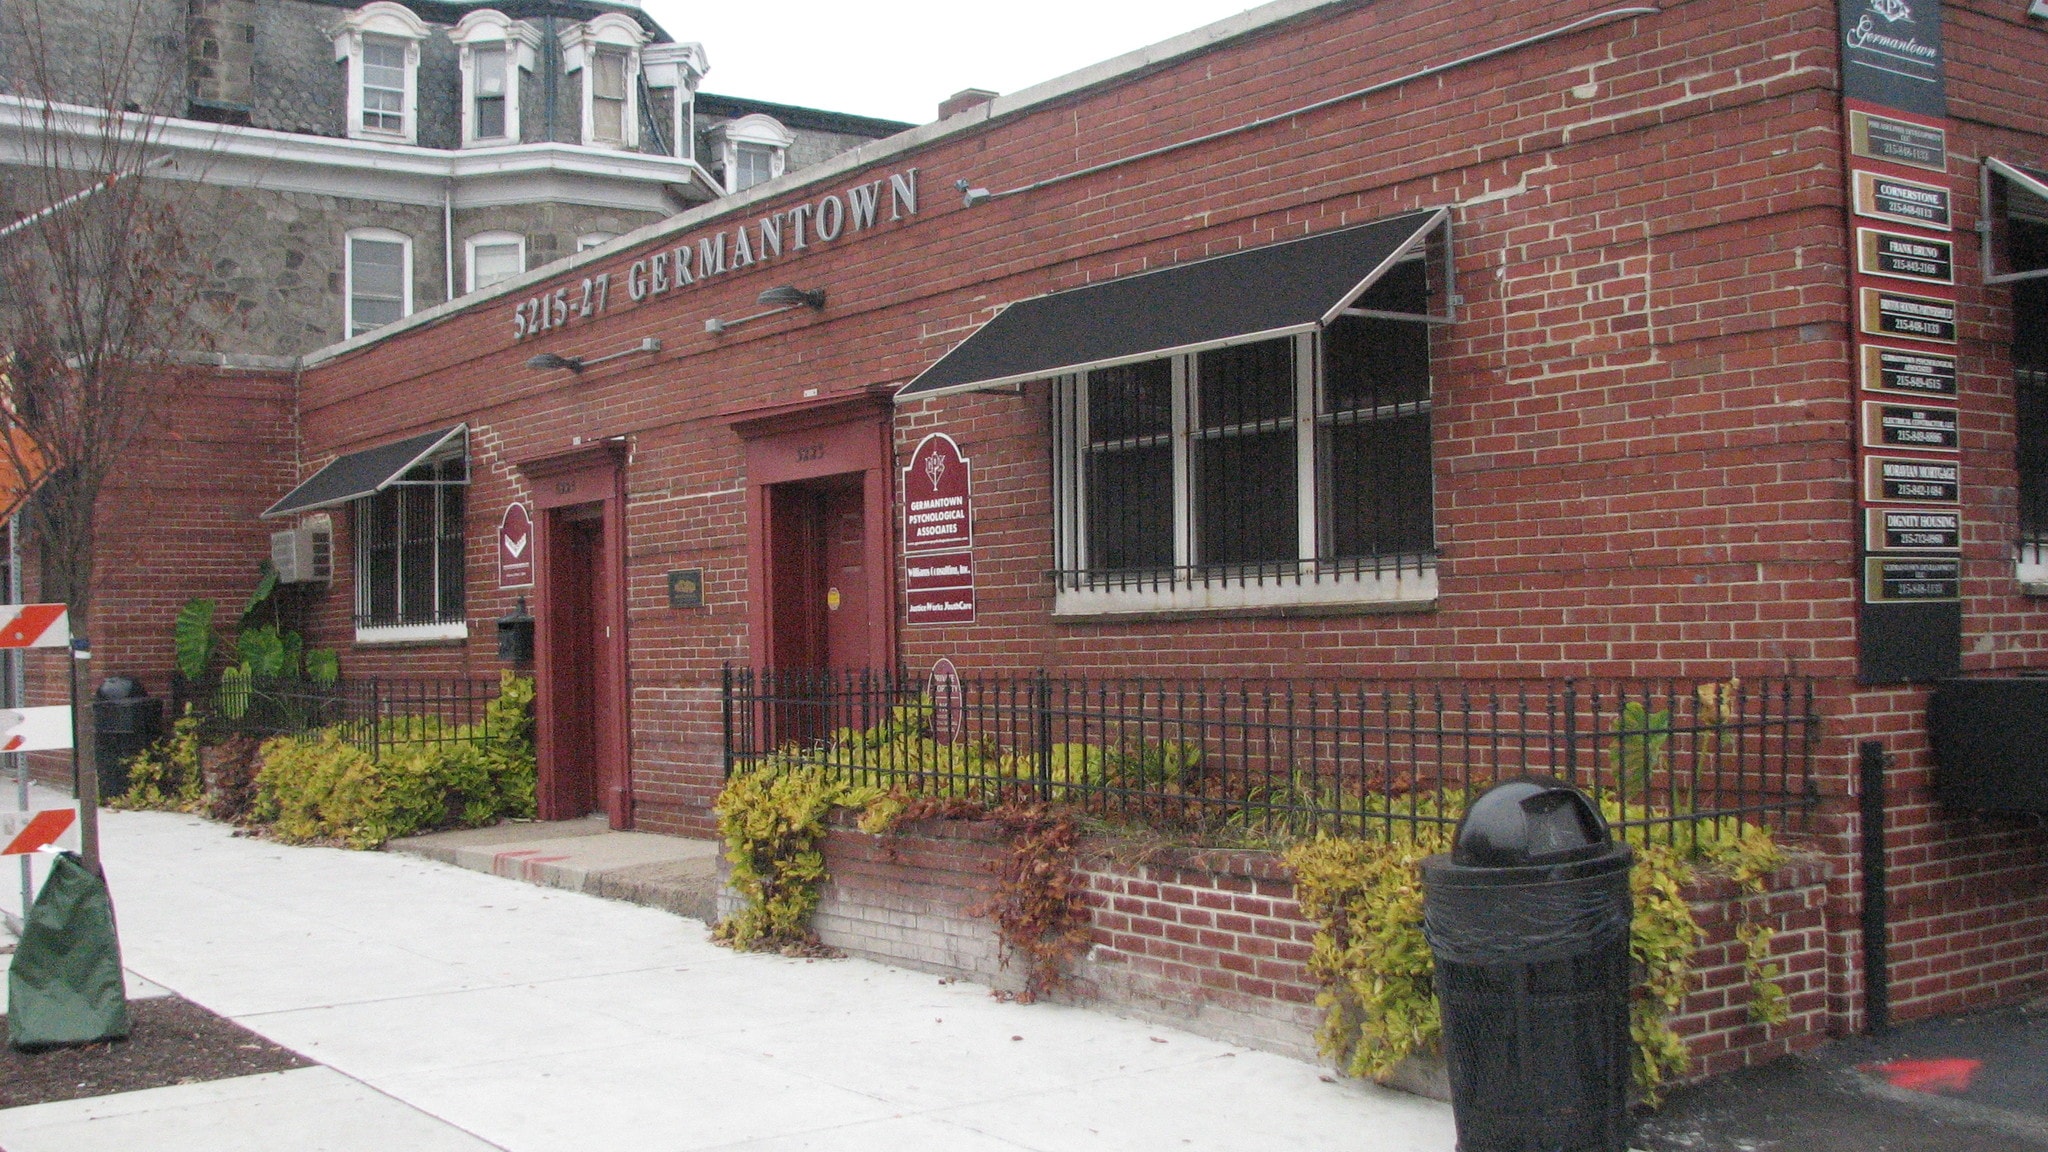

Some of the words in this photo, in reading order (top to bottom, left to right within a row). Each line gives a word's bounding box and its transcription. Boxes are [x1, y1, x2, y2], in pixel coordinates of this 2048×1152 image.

[1846, 15, 1937, 59] Germantown
[1880, 184, 1939, 204] CORNERSTONE
[513, 273, 610, 339] 5215-27
[627, 167, 919, 302] GERMANTOWN
[1889, 241, 1912, 254] FRANK
[1912, 245, 1938, 258] BRUNO
[1919, 466, 1956, 480] MORTGAGE
[910, 496, 963, 511] GERMANTOWN
[908, 509, 965, 524] PSYCHOLOGICAL
[1887, 515, 1919, 527] DIGNITY
[1920, 515, 1956, 527] HOUSING
[916, 523, 958, 536] ASSOCIATES
